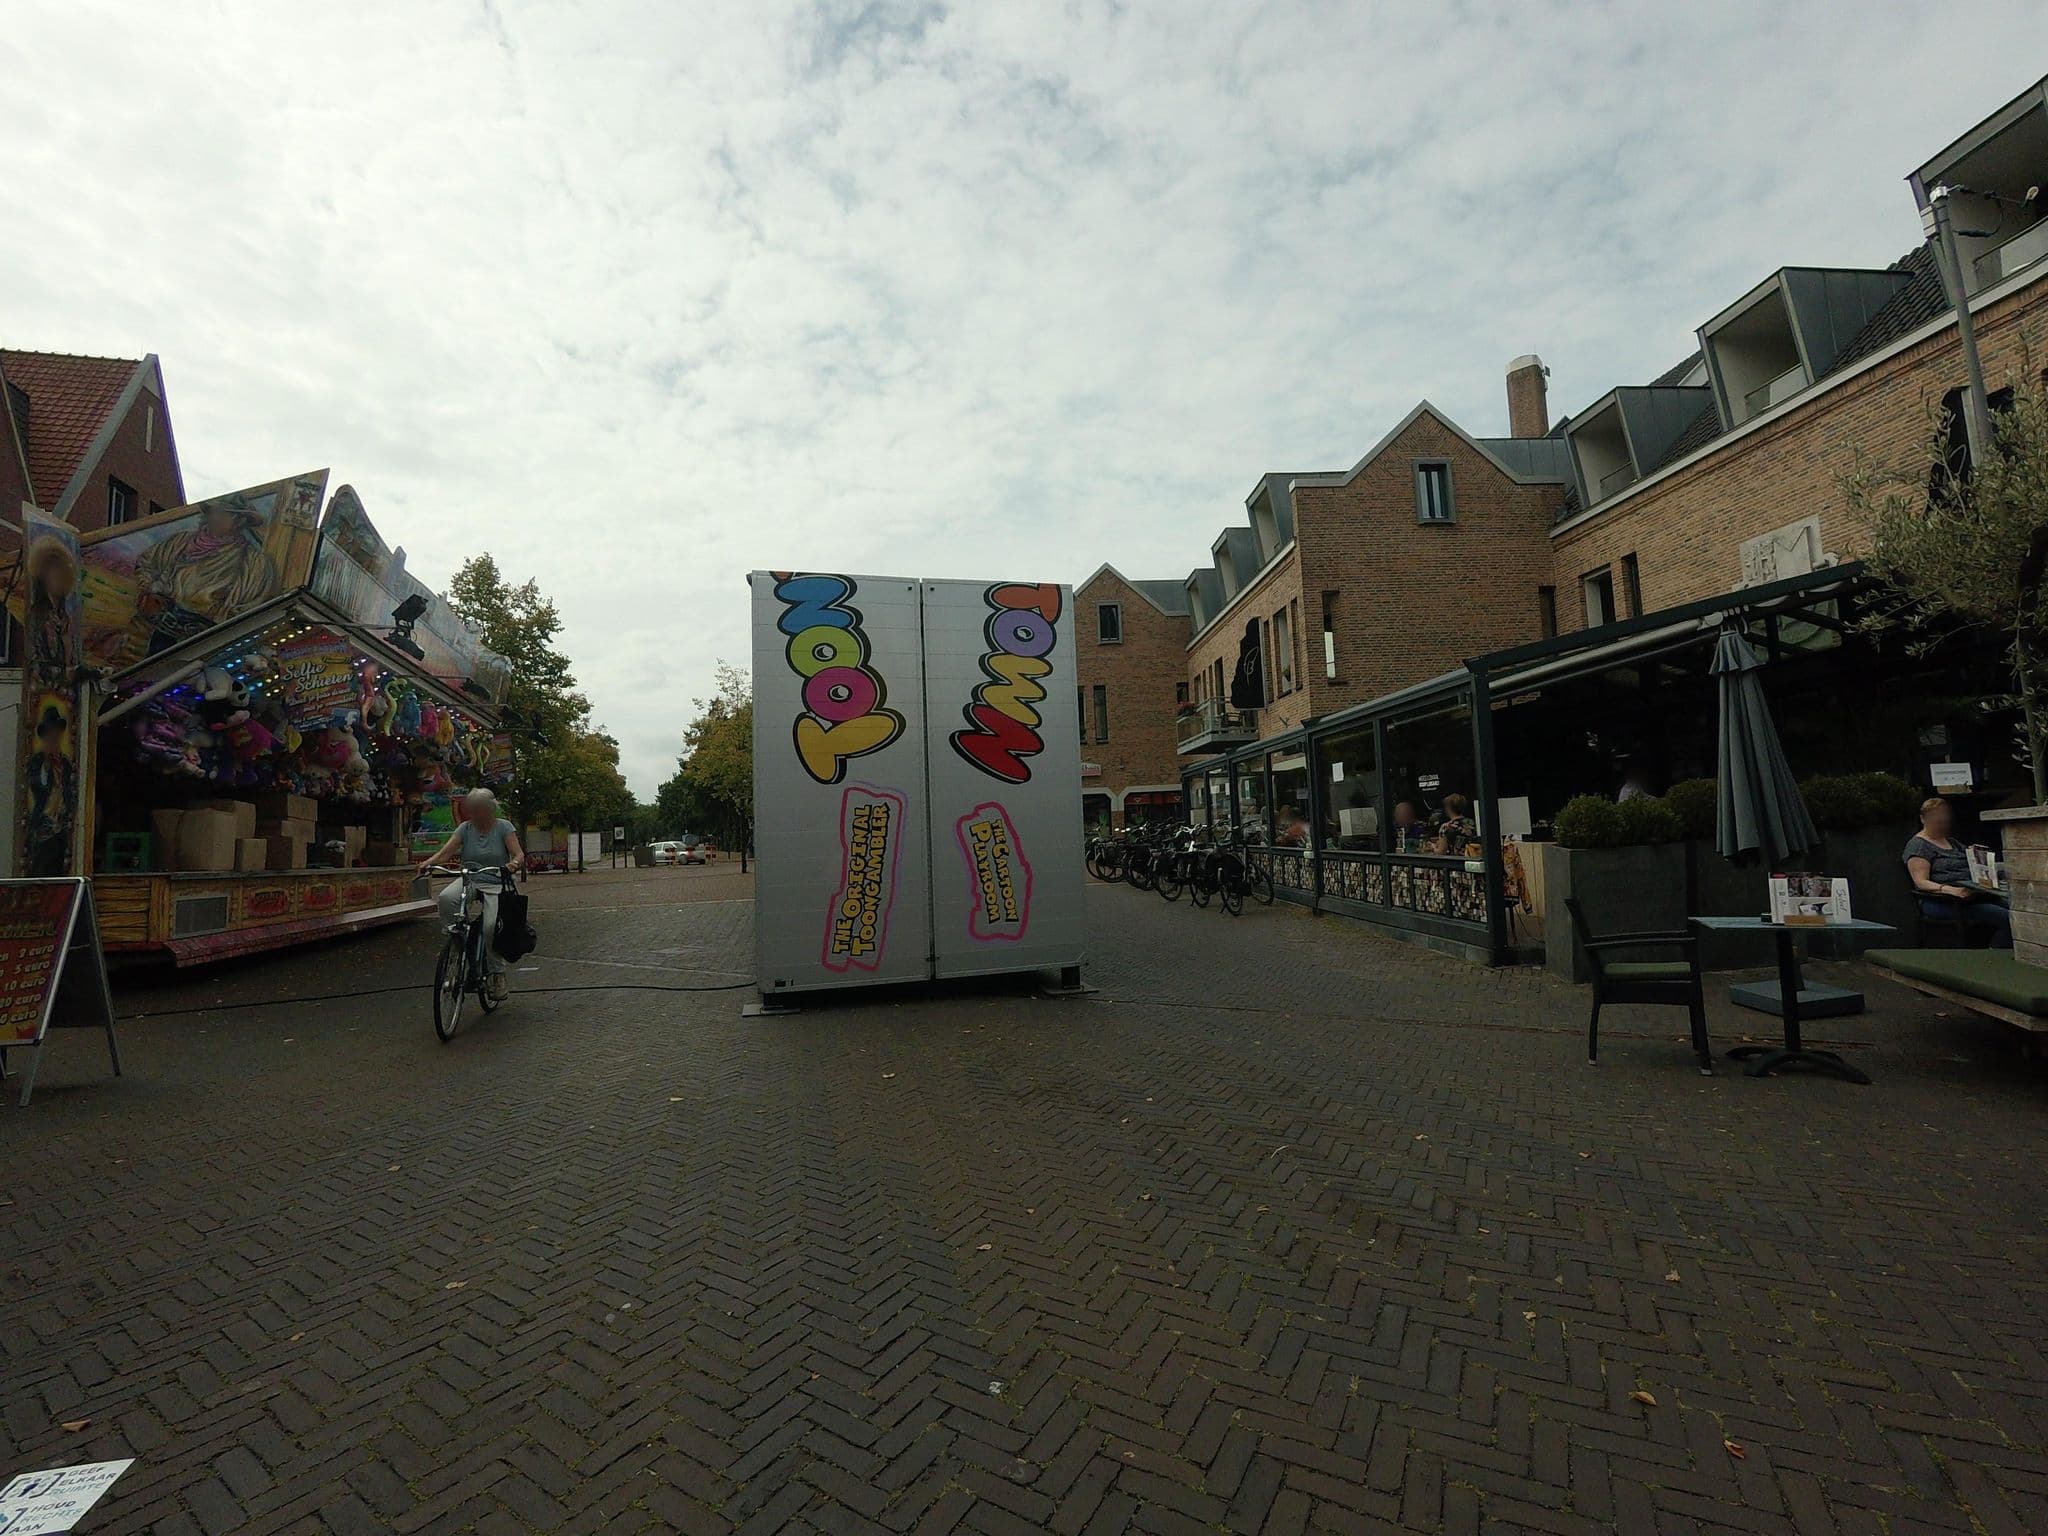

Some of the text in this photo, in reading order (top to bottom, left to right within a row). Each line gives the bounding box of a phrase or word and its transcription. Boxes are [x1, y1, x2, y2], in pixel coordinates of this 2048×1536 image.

[283, 661, 325, 681] Selfie
[773, 574, 906, 784] TOON
[294, 673, 354, 694] Schieten
[949, 582, 1062, 784] TOWN
[969, 820, 1000, 924] PLAYROOM
[991, 819, 1019, 922] THE CARTOON
[832, 804, 872, 954] THE ORIGINAL
[851, 802, 891, 956] TOONGAMBLER
[28, 944, 55, 957] euro
[24, 960, 50, 973] euro
[4, 976, 46, 992] 10 euro
[15, 993, 41, 1005] euro
[10, 1009, 37, 1023] euro
[58, 1472, 117, 1487] ELKAAR
[67, 1466, 106, 1477] GEEF
[30, 1499, 77, 1513] HOUD
[19, 1508, 83, 1525] RECHTS
[8, 1522, 45, 1534] AAN
